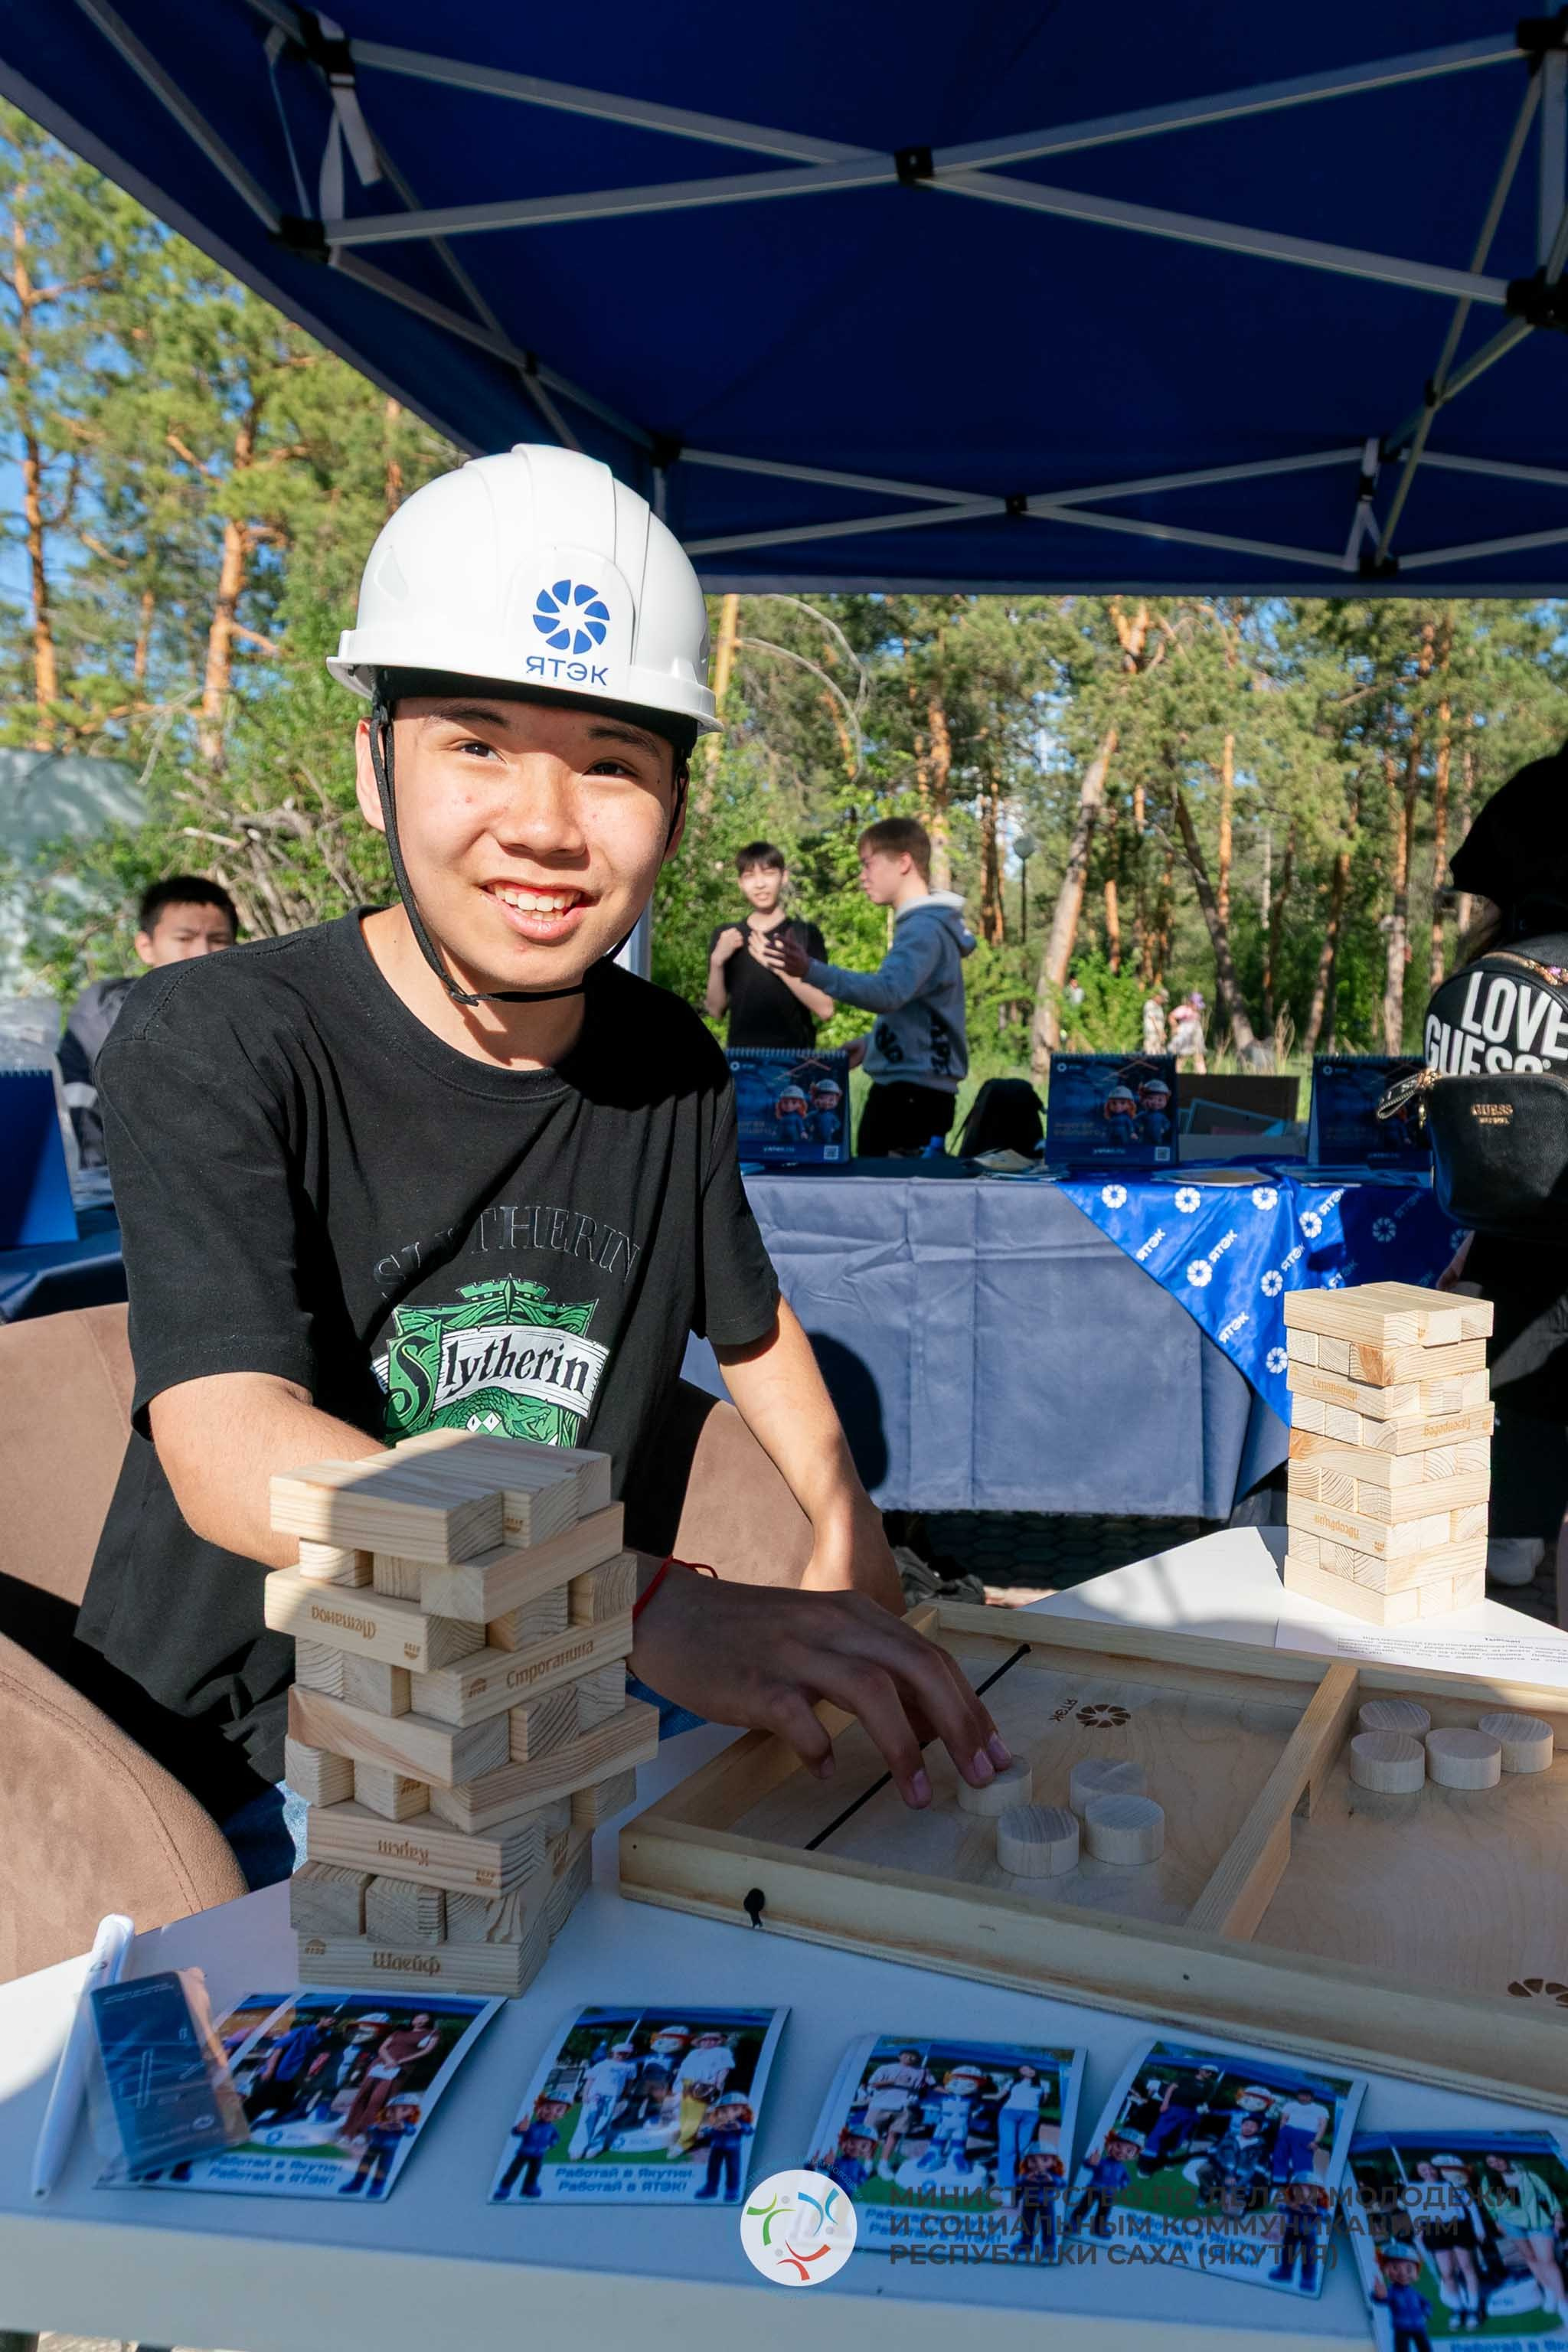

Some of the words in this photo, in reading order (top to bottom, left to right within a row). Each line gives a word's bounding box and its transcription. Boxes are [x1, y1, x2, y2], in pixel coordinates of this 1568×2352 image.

[525, 656, 609, 686] ЯТЭК
[1461, 971, 1568, 1060] LOVE
[1317, 1187, 1347, 1216] ЯТЭК
[373, 1205, 640, 1299] STHERIN
[1136, 1228, 1166, 1262] ЯТЭК
[1208, 1229, 1238, 1263] ЯТЭК
[1281, 1243, 1305, 1272] ЯТЭК
[1218, 1311, 1250, 1344] ЯТЭК
[384, 1333, 590, 1431] Slytherin
[506, 1638, 594, 1690] Строганина
[1047, 1698, 1078, 1722] ЯТЭК
[377, 1839, 430, 1867] Карст
[372, 1951, 442, 1978] Шлейф
[555, 2167, 619, 2178] Работай
[558, 2180, 622, 2192] Работай
[642, 2180, 688, 2193] ЯТЭК!
